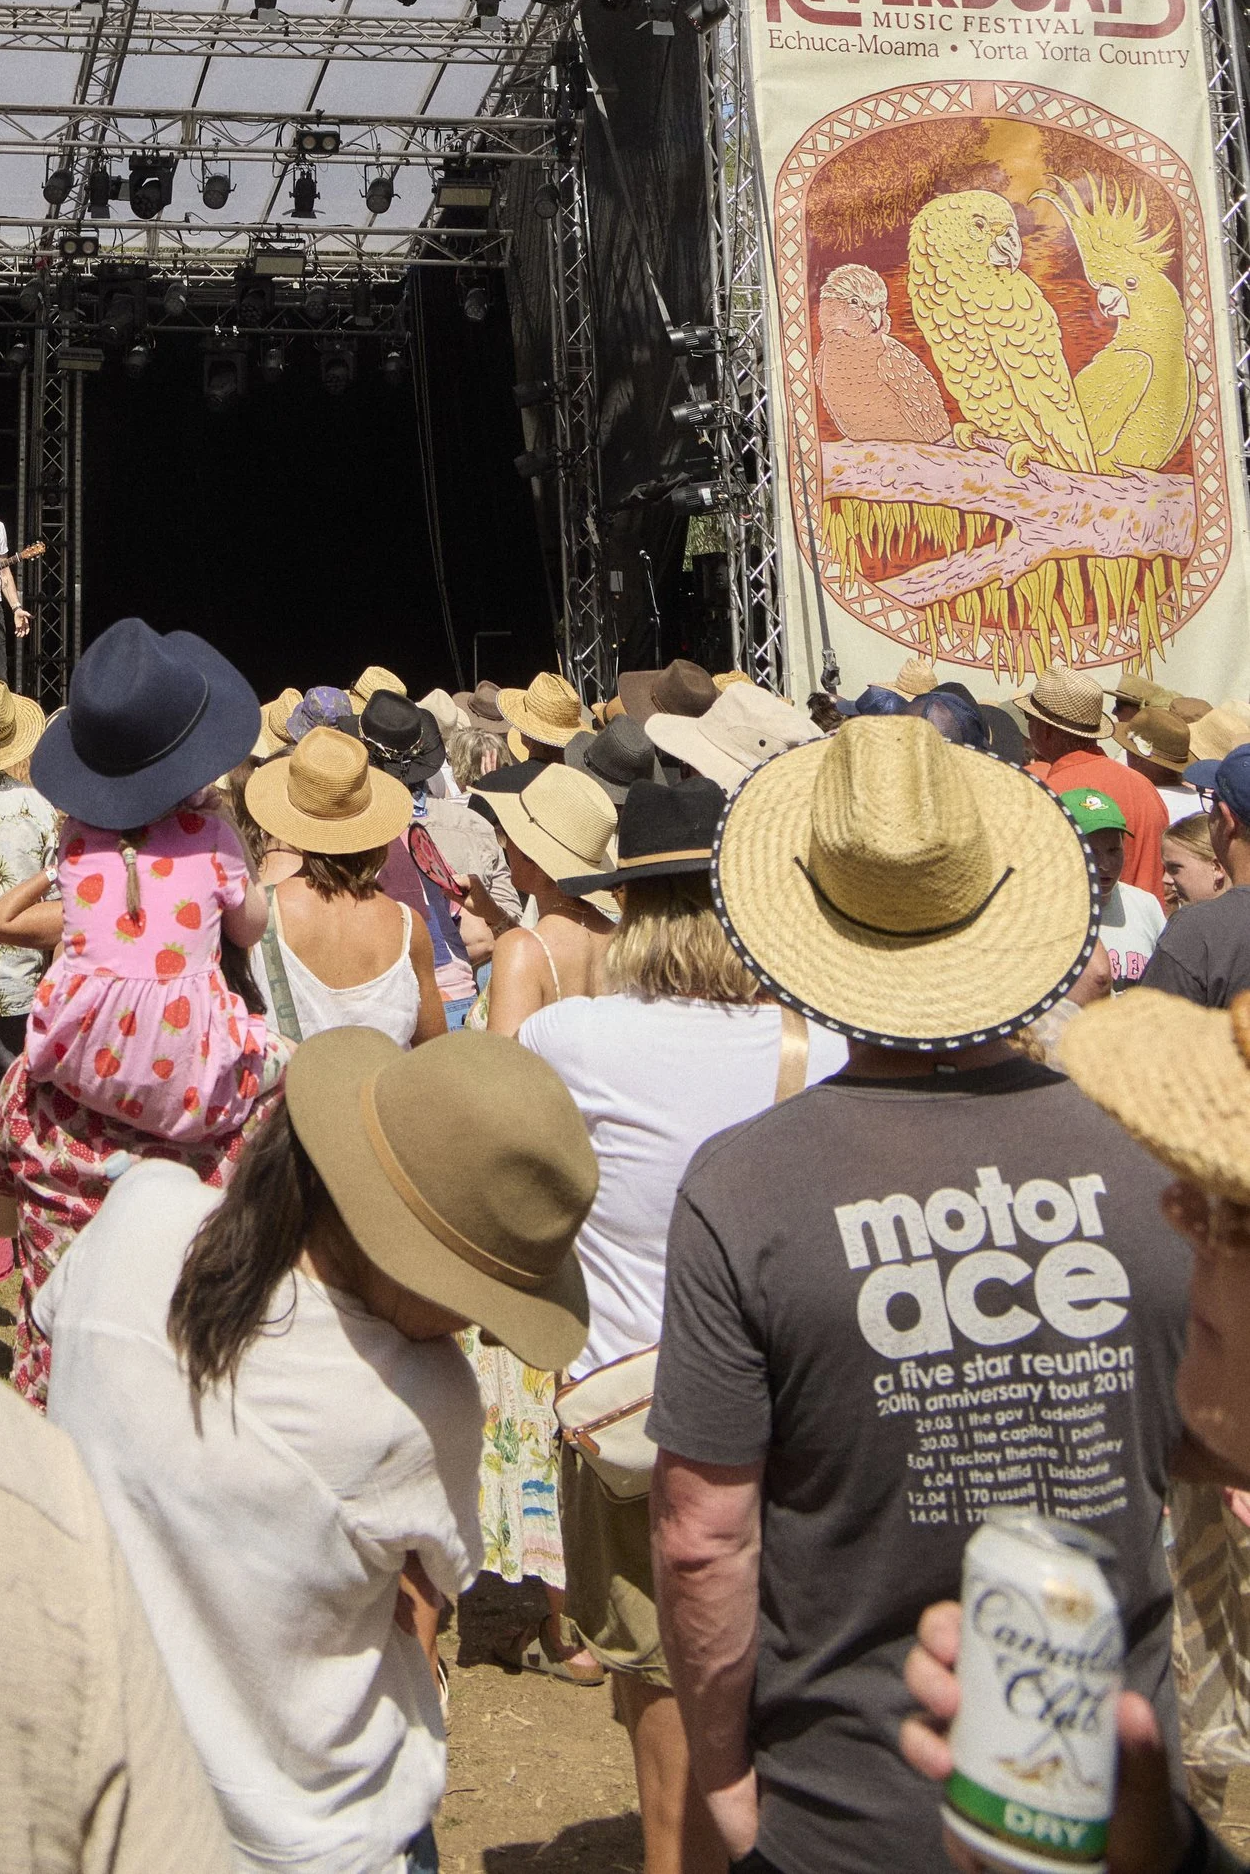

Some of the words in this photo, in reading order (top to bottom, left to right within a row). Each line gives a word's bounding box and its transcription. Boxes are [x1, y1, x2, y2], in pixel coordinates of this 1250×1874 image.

[873, 11, 953, 31] MUSIC
[963, 16, 1084, 35] FESTIVAL
[768, 29, 939, 58] Echuca-Moama
[969, 40, 1028, 60] Yorta
[1036, 41, 1092, 63] Yorta
[1099, 44, 1190, 68] Country
[834, 1166, 1107, 1270] motor
[857, 1241, 1130, 1359] ace
[874, 1374, 895, 1395] a
[900, 1361, 954, 1390] five
[962, 1353, 1014, 1383] star
[1021, 1341, 1134, 1376] reunion
[877, 1394, 920, 1417] 20th
[925, 1382, 1043, 1412] anniversary
[1048, 1379, 1090, 1401] tour
[968, 1412, 992, 1426] the
[994, 1407, 1023, 1425] gov
[1040, 1402, 1106, 1421] adelaide
[920, 1435, 959, 1451] 30.03
[973, 1430, 997, 1444] the
[1000, 1424, 1053, 1443] capitol
[1071, 1421, 1106, 1442] perth
[950, 1448, 1002, 1466] factory
[1005, 1443, 1059, 1460] theatre
[1076, 1438, 1123, 1461] sydney
[923, 1471, 954, 1487] 6.04
[968, 1469, 993, 1484] the
[1048, 1461, 1110, 1480] brisbane
[907, 1490, 946, 1506] 12.04
[964, 1488, 990, 1503] 170
[992, 1481, 1036, 1502] russell
[1053, 1476, 1126, 1501] melbourne
[909, 1508, 948, 1524] 14.04
[1055, 1496, 1128, 1521] melbourne
[1003, 1800, 1088, 1849] DRY
